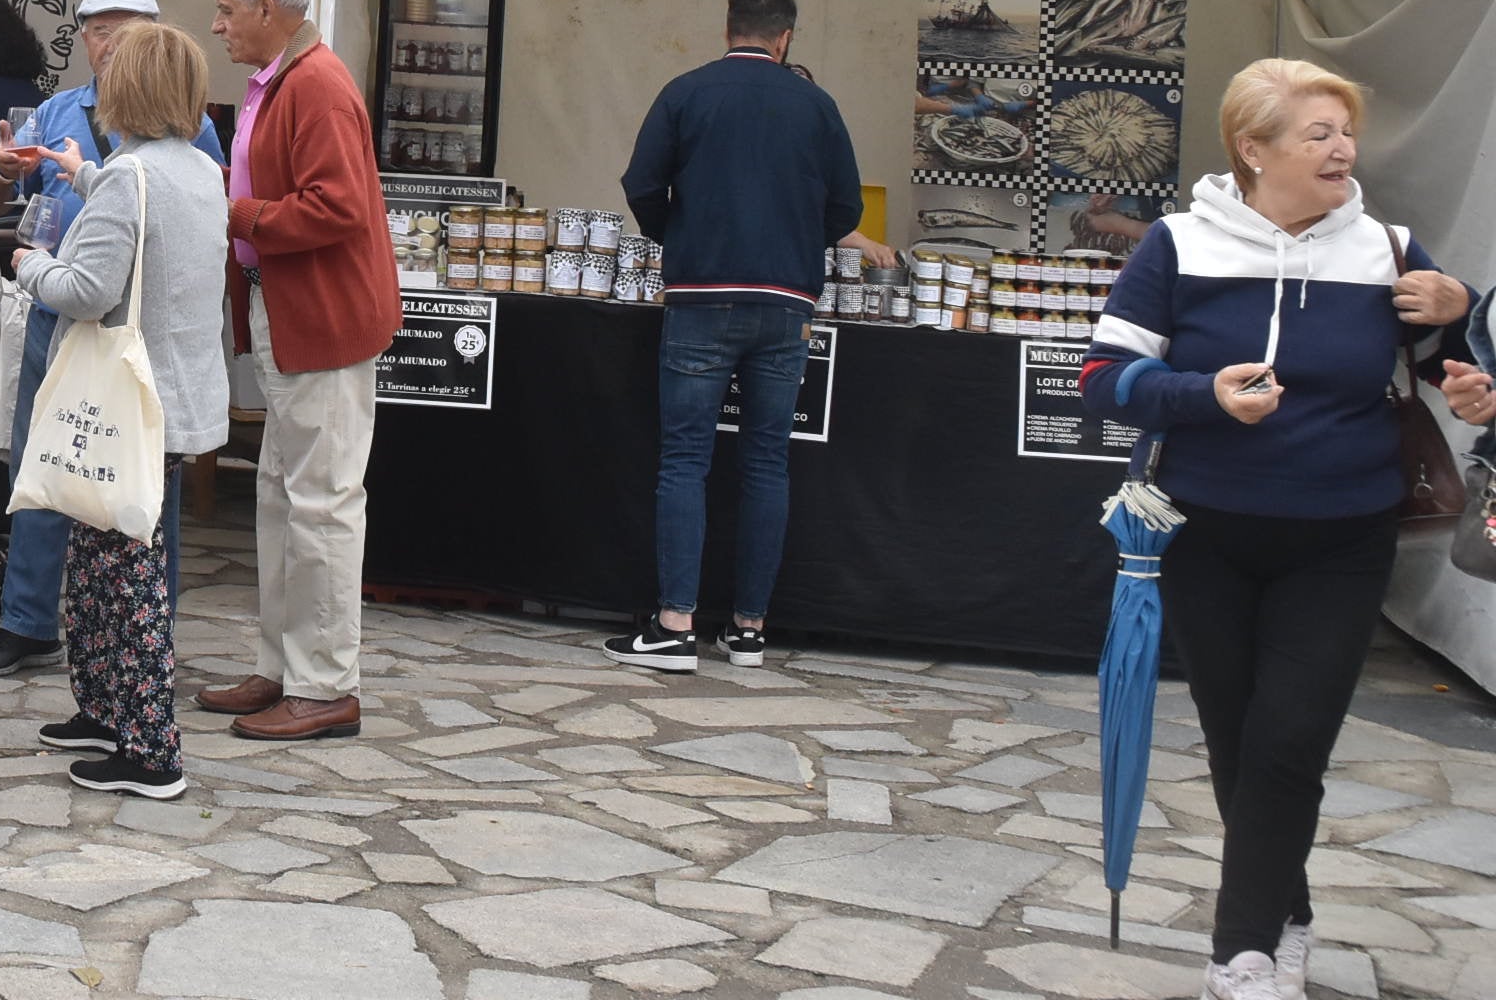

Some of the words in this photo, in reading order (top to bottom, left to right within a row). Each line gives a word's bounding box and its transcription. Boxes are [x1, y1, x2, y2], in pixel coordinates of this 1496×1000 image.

[402, 301, 488, 316] ELICATESSEN
[398, 357, 446, 367] AHUMADO
[1036, 378, 1064, 388] LOTE
[453, 386, 470, 395] 25€
